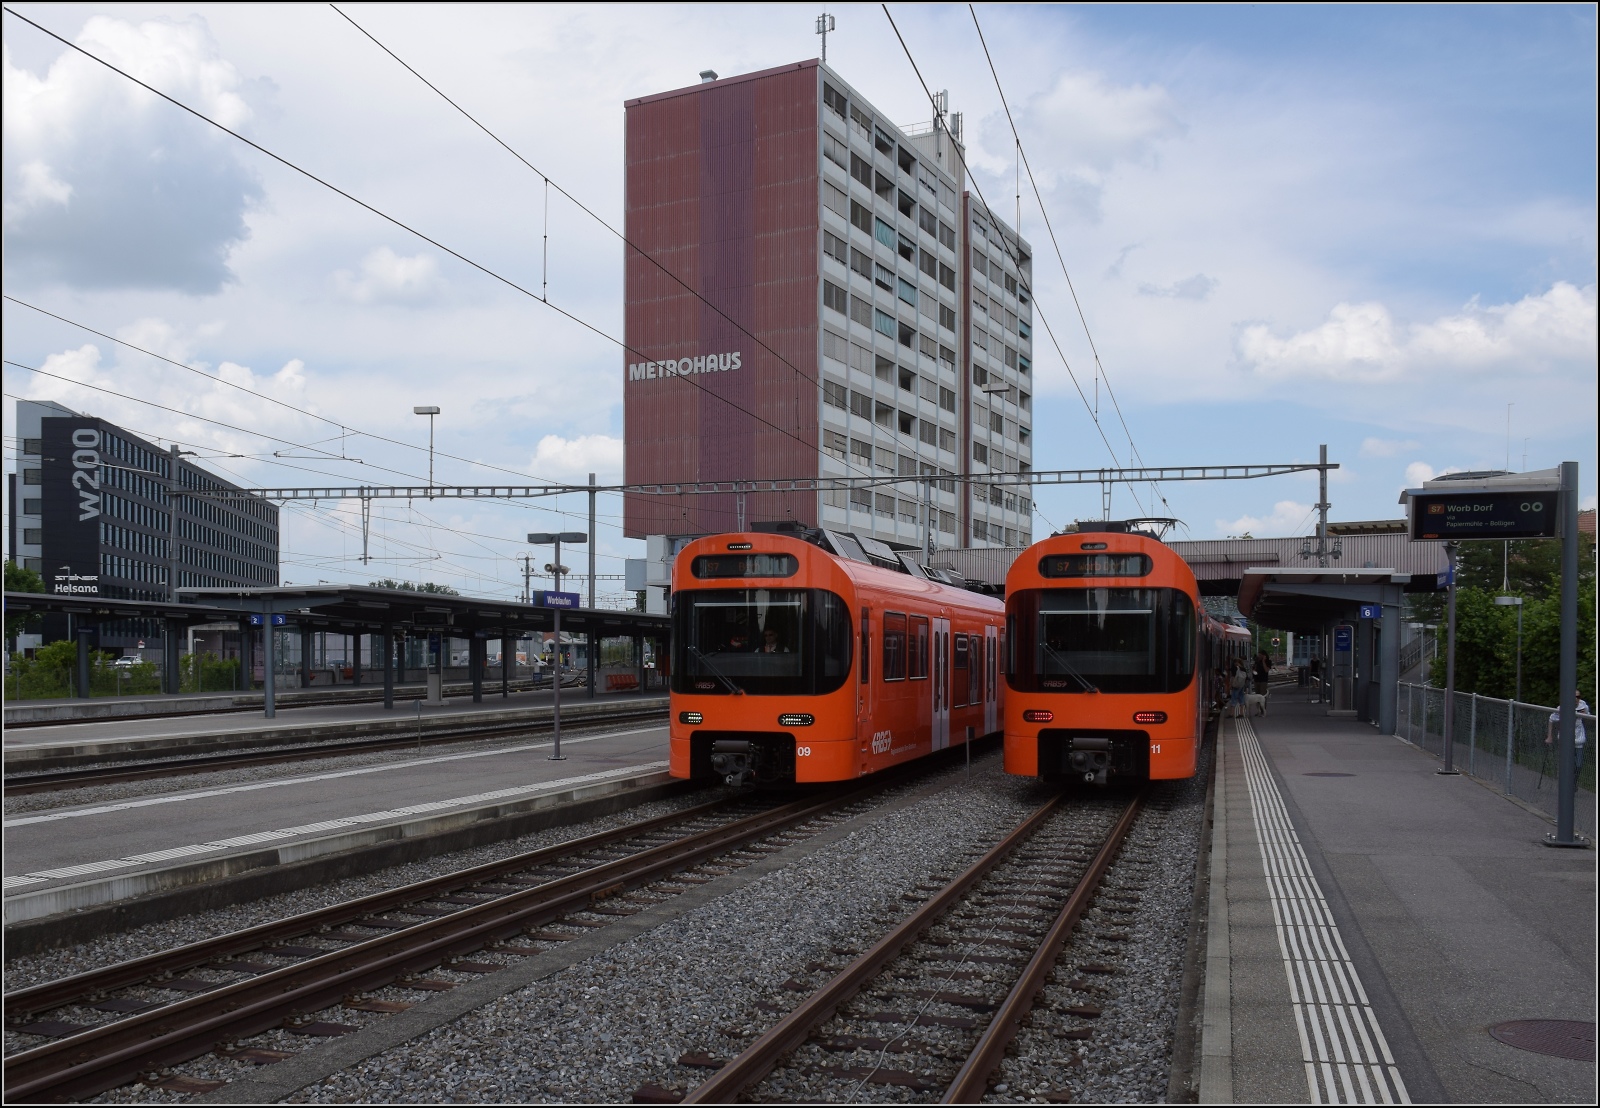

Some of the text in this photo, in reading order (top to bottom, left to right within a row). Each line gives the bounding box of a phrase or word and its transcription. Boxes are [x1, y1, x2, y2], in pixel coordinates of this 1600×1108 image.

[629, 351, 741, 381] METROHAUS
[1430, 503, 1494, 513] S7 Worb Dorf
[1057, 561, 1070, 571] S7
[55, 583, 98, 593] Helsana
[1364, 609, 1371, 617] 6
[797, 746, 811, 757] 09
[1150, 744, 1161, 754] 11
